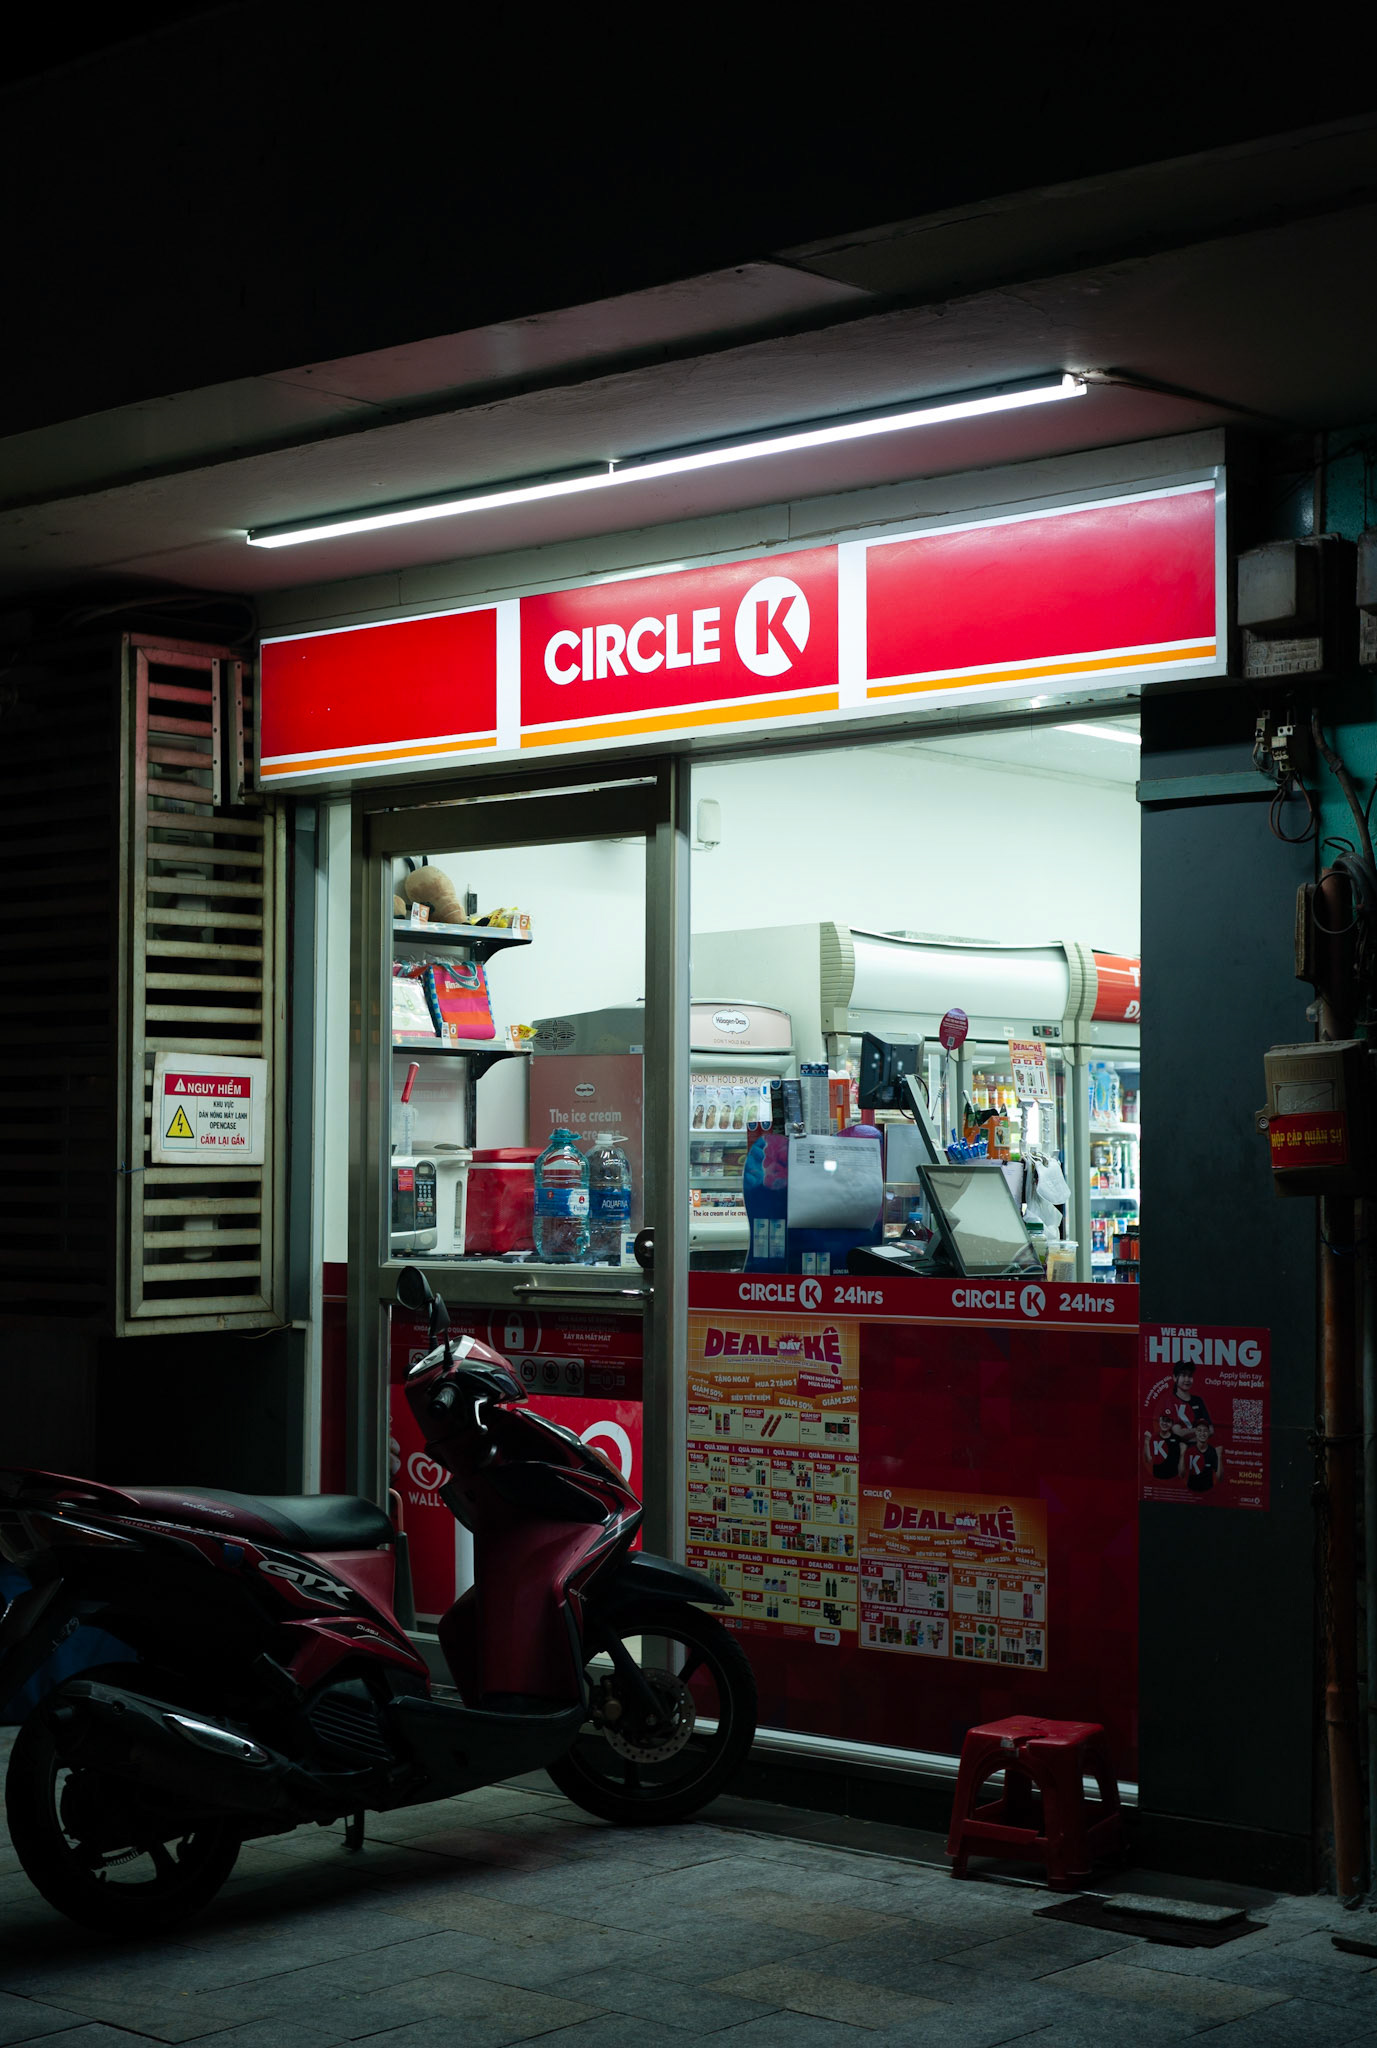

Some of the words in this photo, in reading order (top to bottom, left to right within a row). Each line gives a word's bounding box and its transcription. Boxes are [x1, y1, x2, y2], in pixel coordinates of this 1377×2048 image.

[543, 606, 721, 686] CIRCLE
[740, 581, 810, 676] K
[187, 1083, 215, 1095] NGUY
[217, 1079, 242, 1095] HIỂM
[691, 1074, 715, 1083] DON'T
[717, 1075, 738, 1084] HOLD
[739, 1076, 759, 1085] BACK
[549, 1109, 569, 1123] The
[571, 1108, 587, 1123] ice
[588, 1111, 622, 1122] cream
[209, 1121, 237, 1130] OPENCASE
[200, 1132, 216, 1145] CẤM
[218, 1135, 230, 1147] LẠI
[738, 1282, 796, 1303] CIRCLE
[801, 1280, 822, 1309] K
[834, 1286, 884, 1305] 24hrs
[951, 1288, 1016, 1310] CIRCLE
[1022, 1286, 1046, 1317] K
[1059, 1293, 1115, 1313] 24hrs
[1160, 1327, 1177, 1337] WE
[1178, 1328, 1198, 1338] ARE
[703, 1327, 778, 1359] DEAL
[802, 1326, 843, 1376] KỆ
[1148, 1335, 1263, 1368] HIRING
[769, 1379, 776, 1387] 2
[1219, 1371, 1239, 1381] Apply
[692, 1384, 710, 1395] GIẢM
[710, 1389, 724, 1398] 50%
[1222, 1380, 1238, 1388] ngay
[1250, 1380, 1264, 1389] job!
[779, 1397, 798, 1408] GIẢM
[798, 1402, 814, 1410] 50%
[822, 1396, 841, 1406] GIẢM
[841, 1395, 857, 1404] 25%
[408, 1491, 447, 1507] WALL
[863, 1489, 883, 1497] CIRCLE
[119, 1518, 171, 1534] AUTOMATIC
[883, 1502, 955, 1531] DEAL
[979, 1505, 1017, 1550] KỆ
[258, 1560, 353, 1601] GTX
